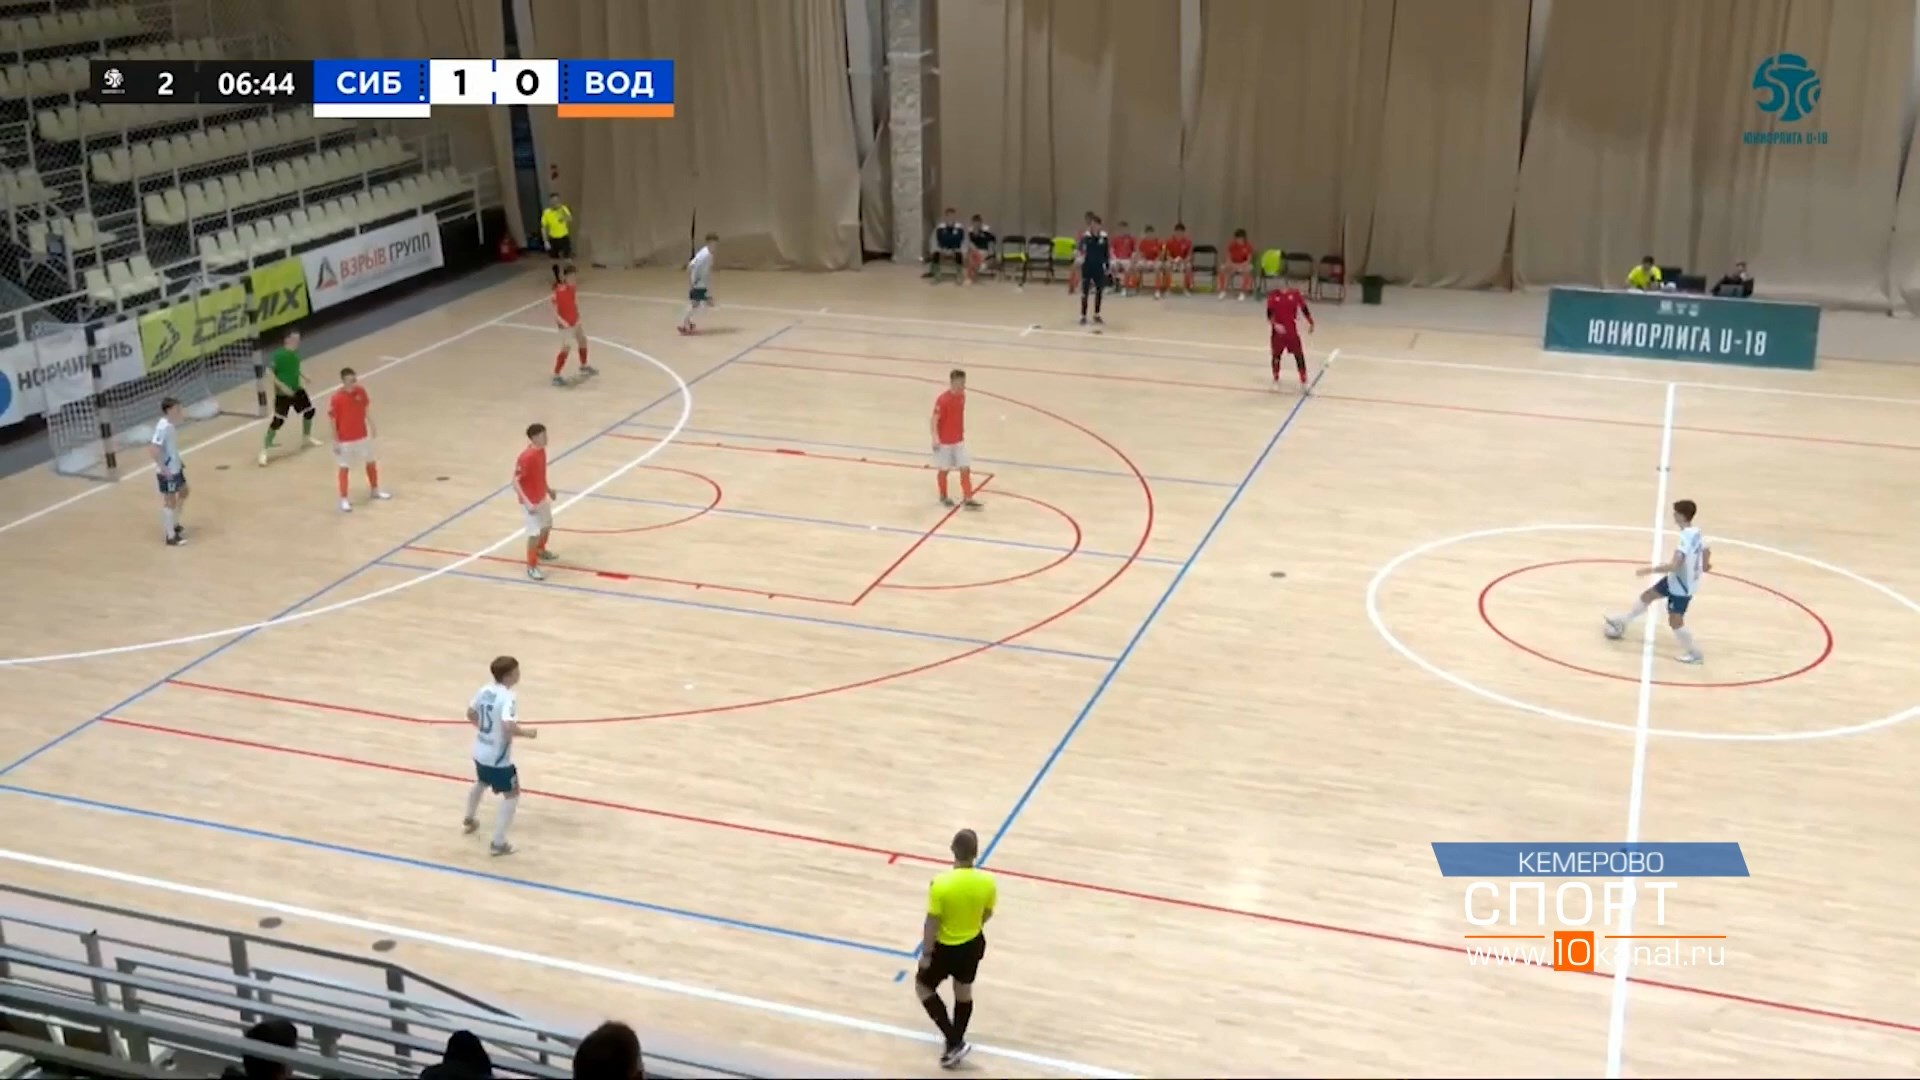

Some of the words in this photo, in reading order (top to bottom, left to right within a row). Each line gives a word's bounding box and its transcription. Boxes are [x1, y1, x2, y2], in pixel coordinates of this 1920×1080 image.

[339, 246, 388, 281] ВЗРЫВ
[388, 230, 432, 263] ГРУПП
[1587, 318, 1712, 354] ЮНИОРЛИГА
[1718, 327, 1768, 358] U-18
[480, 704, 494, 734] 15
